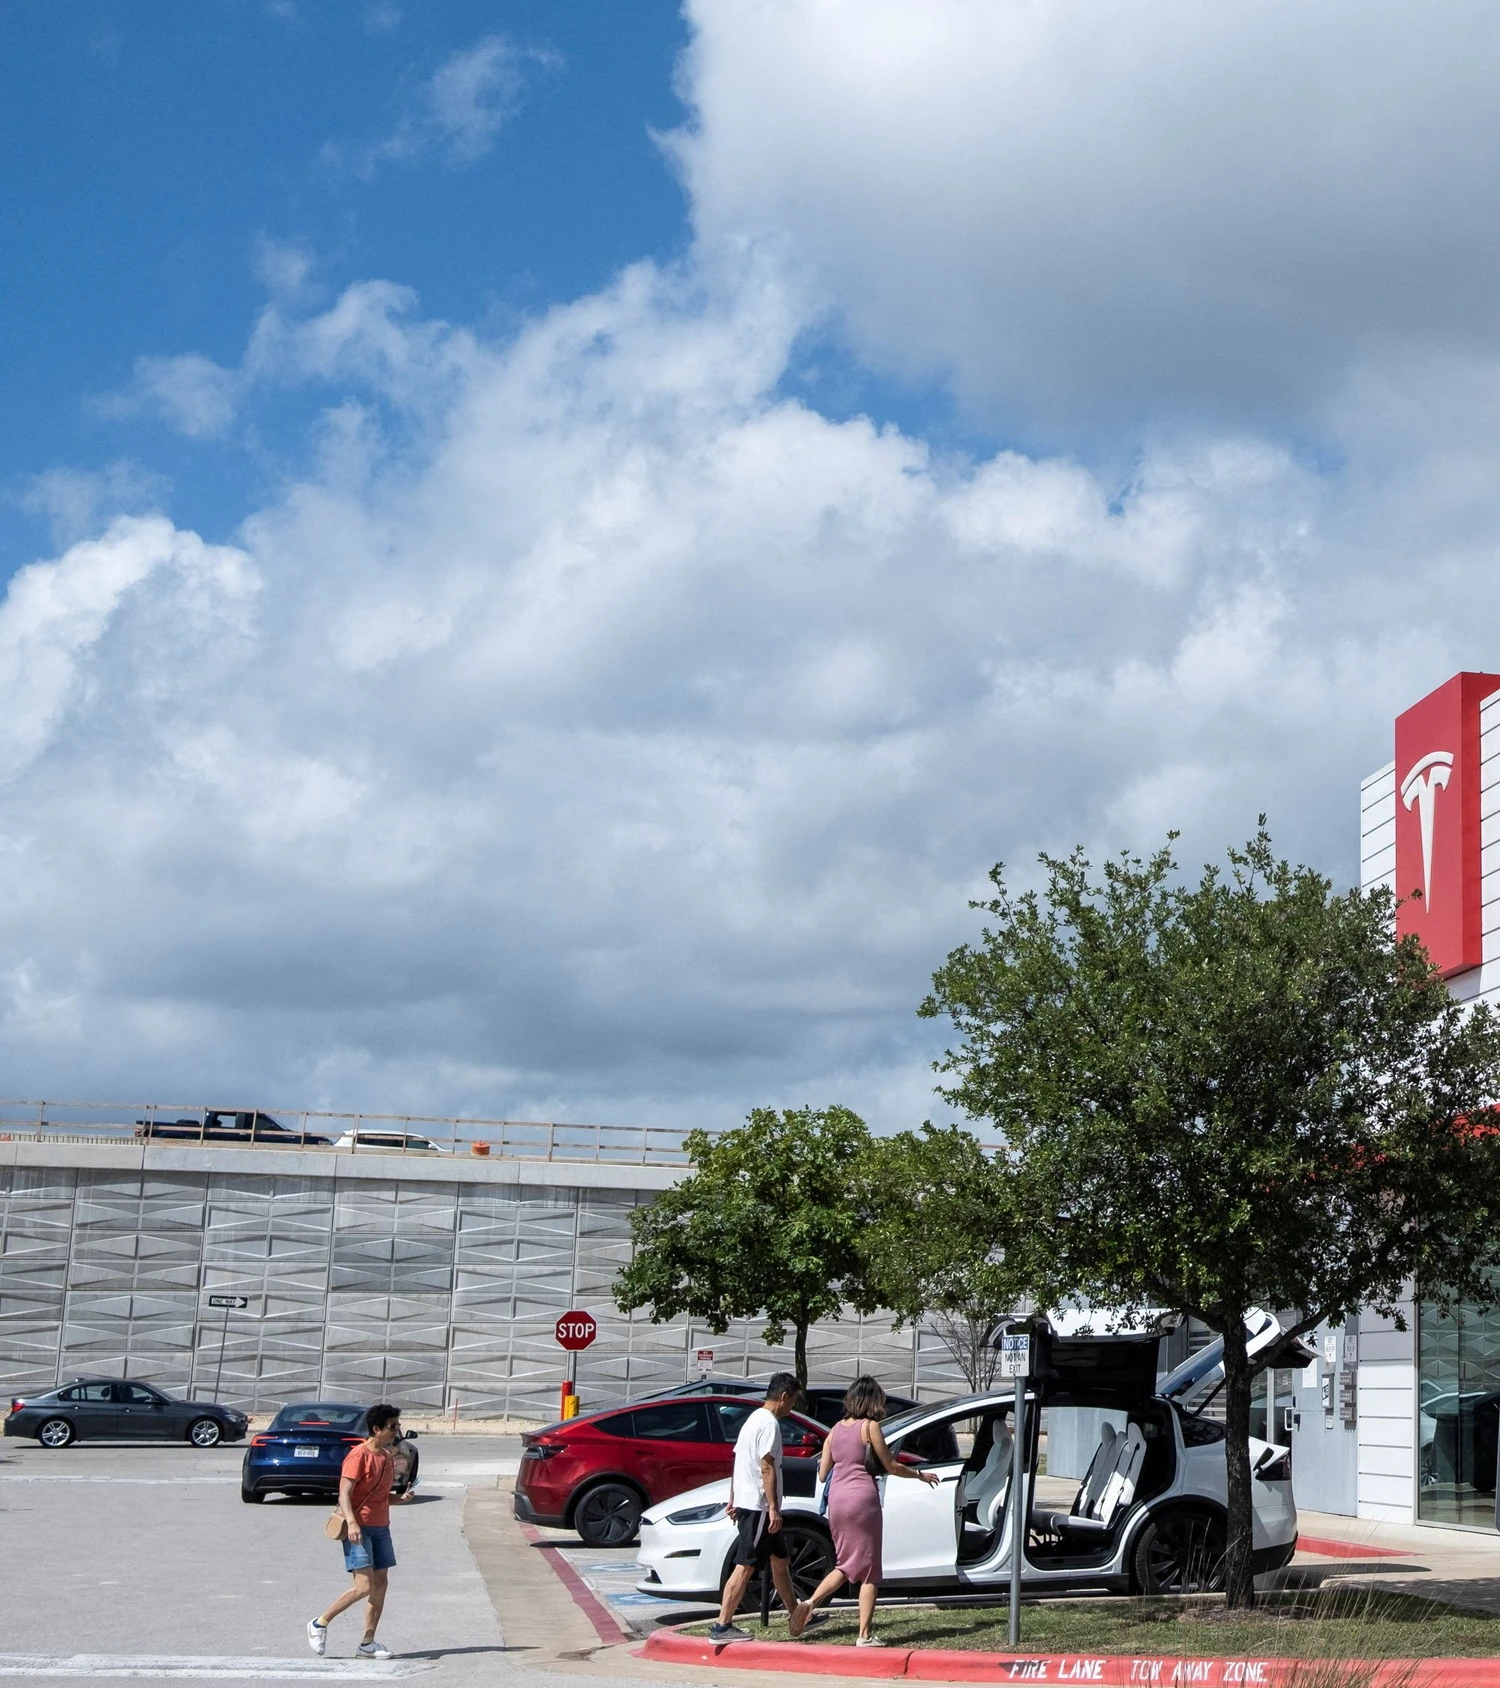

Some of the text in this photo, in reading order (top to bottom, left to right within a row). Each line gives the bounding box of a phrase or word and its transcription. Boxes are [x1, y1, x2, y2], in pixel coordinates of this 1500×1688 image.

[558, 1322, 595, 1338] STOP
[1003, 1337, 1028, 1350] NOTICE
[1004, 1352, 1016, 1362] NOT
[1009, 1364, 1021, 1374] EXIT
[1009, 1659, 1269, 1682] FIRE LANE TOW AWAY ZONE
